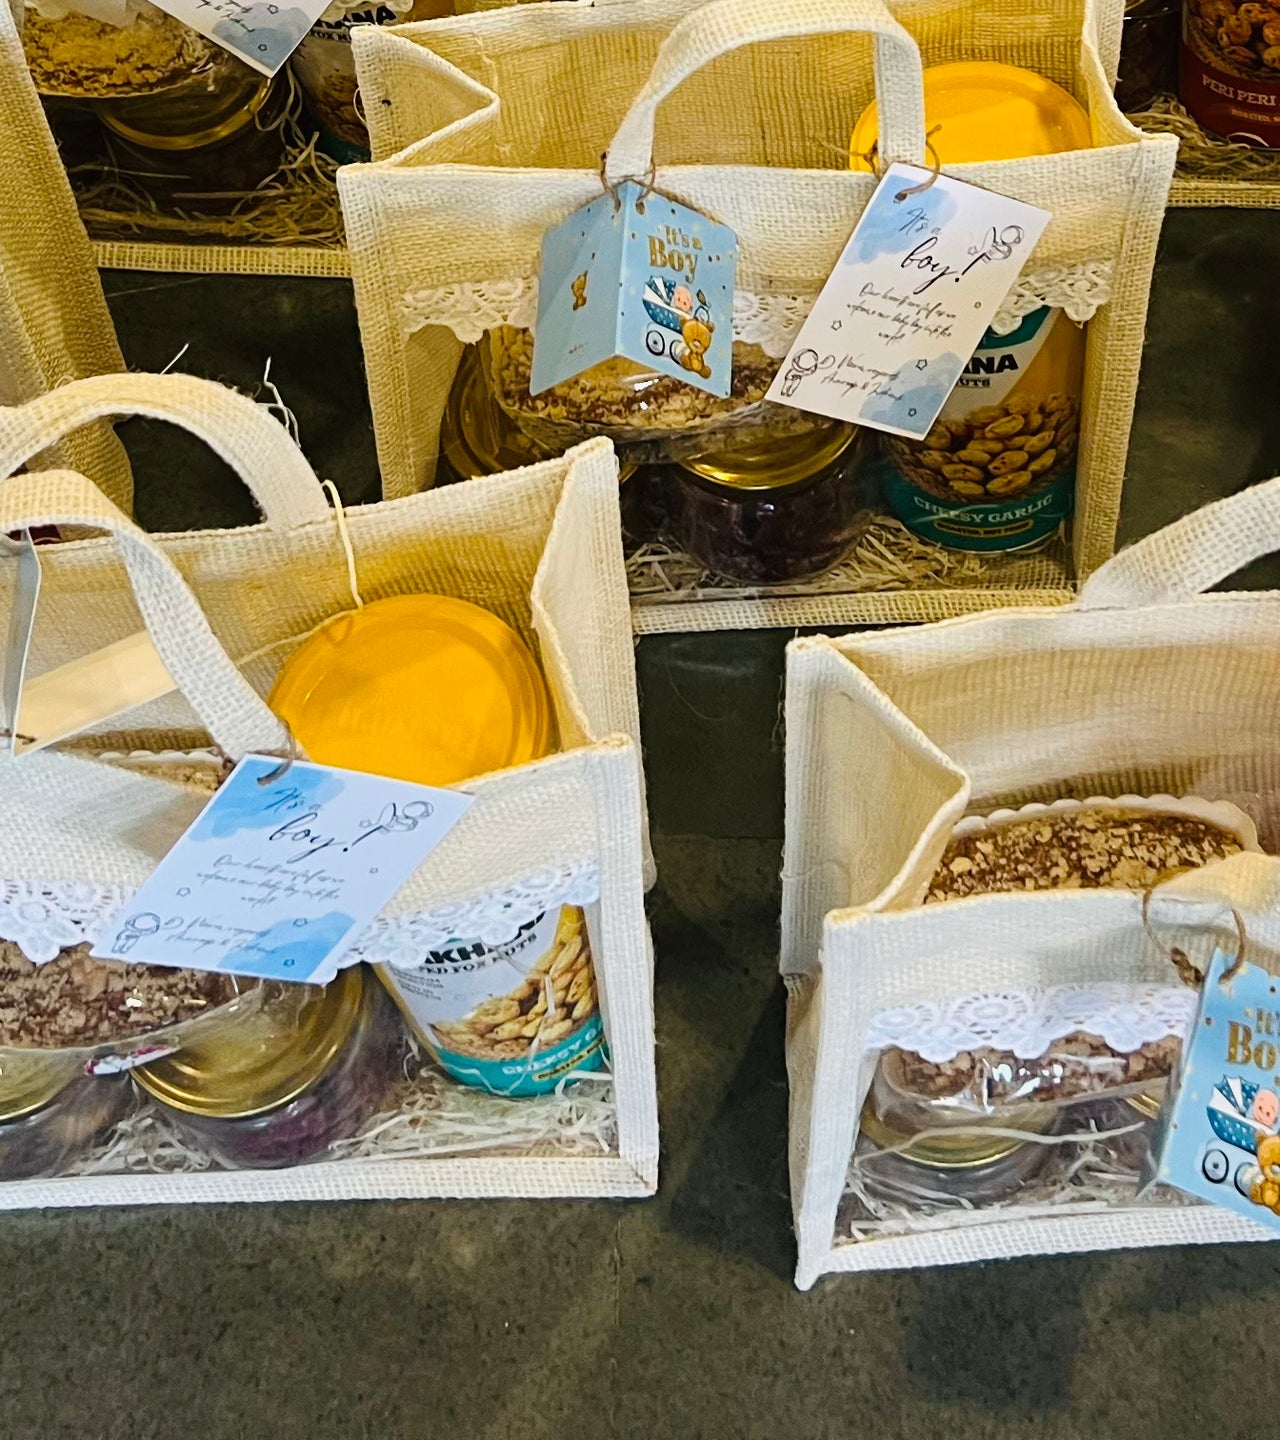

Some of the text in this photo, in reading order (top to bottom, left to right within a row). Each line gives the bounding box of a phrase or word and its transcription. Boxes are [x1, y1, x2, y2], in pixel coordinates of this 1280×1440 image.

[1201, 73, 1234, 100] PERI
[1237, 90, 1278, 105] PERI
[647, 233, 700, 284] Boy
[900, 236, 990, 294] boy!
[987, 494, 1054, 523] GARLIC
[268, 810, 382, 864] boy!
